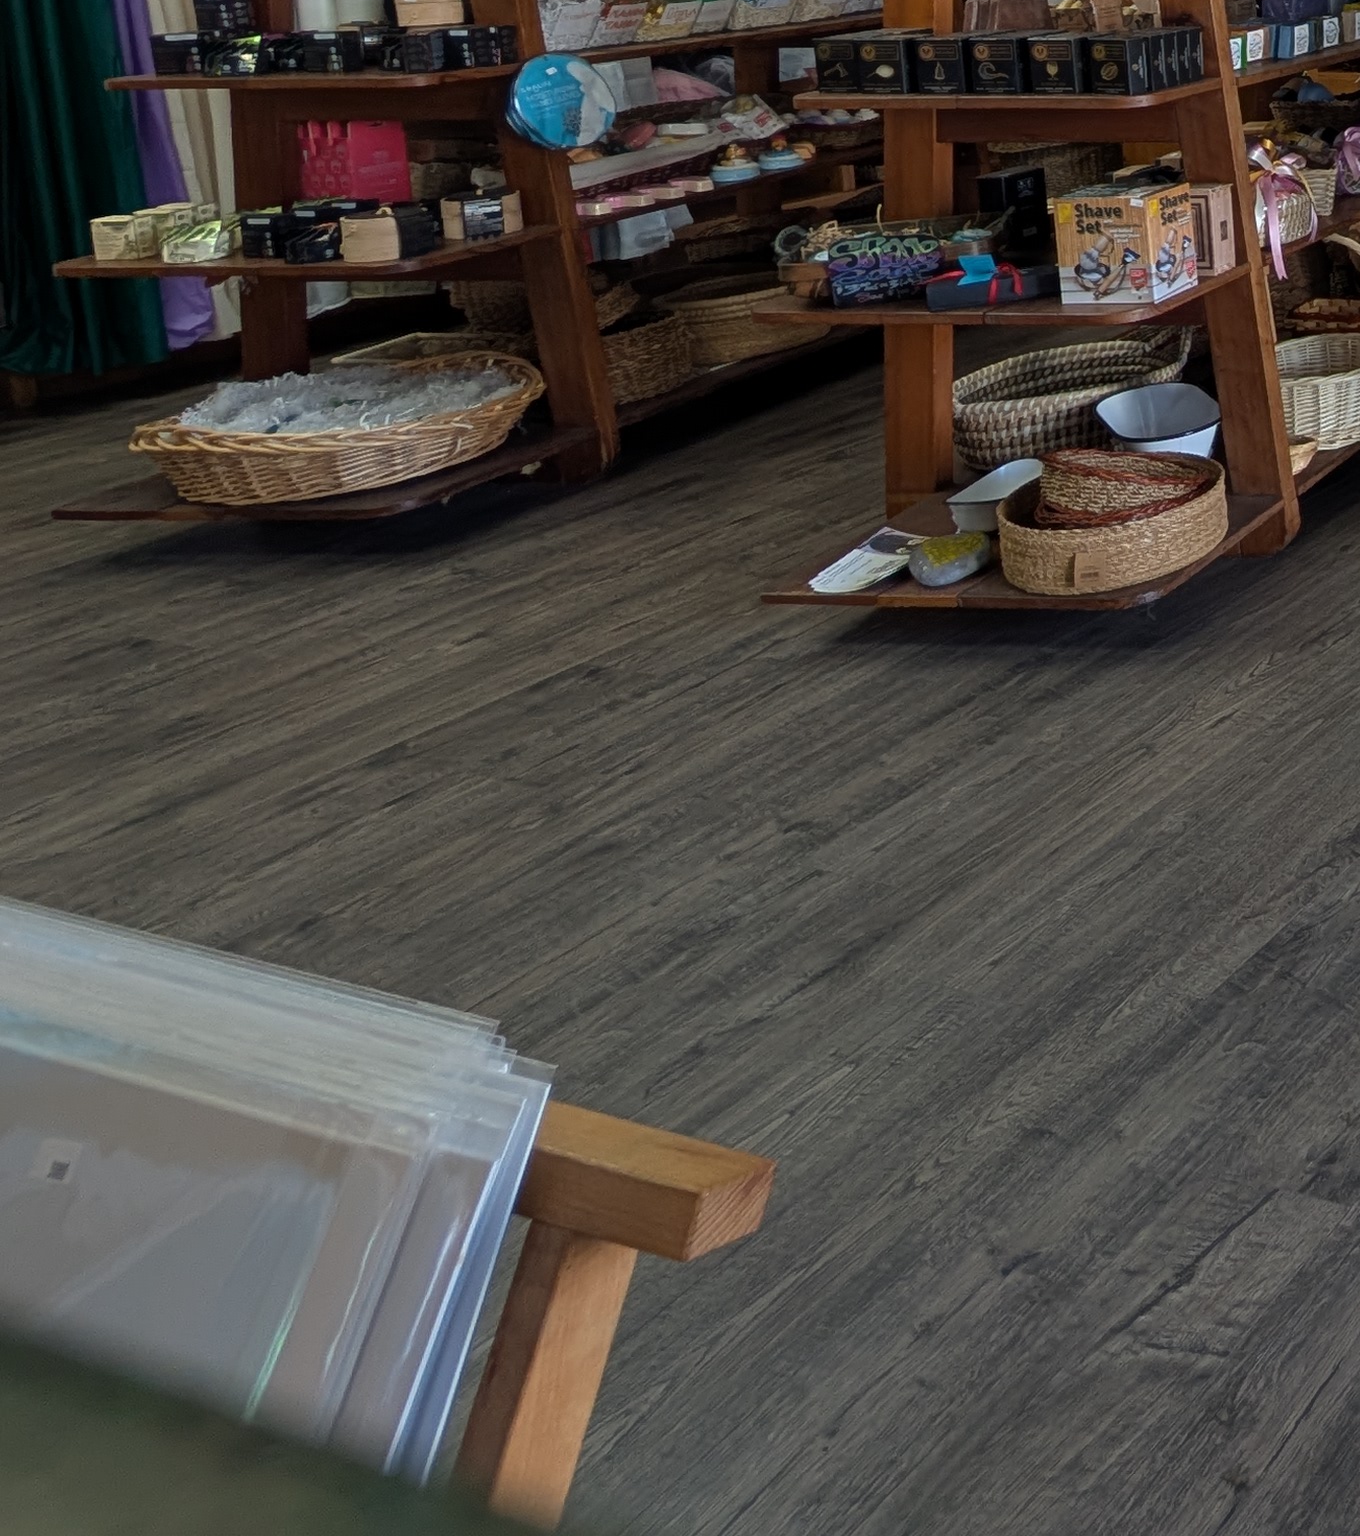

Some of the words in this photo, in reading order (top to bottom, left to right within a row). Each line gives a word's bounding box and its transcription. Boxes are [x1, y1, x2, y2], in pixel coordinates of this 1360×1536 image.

[1159, 192, 1189, 211] Shave
[1074, 203, 1123, 219] Shave
[1161, 211, 1178, 226] Set
[1076, 220, 1101, 234] Set
